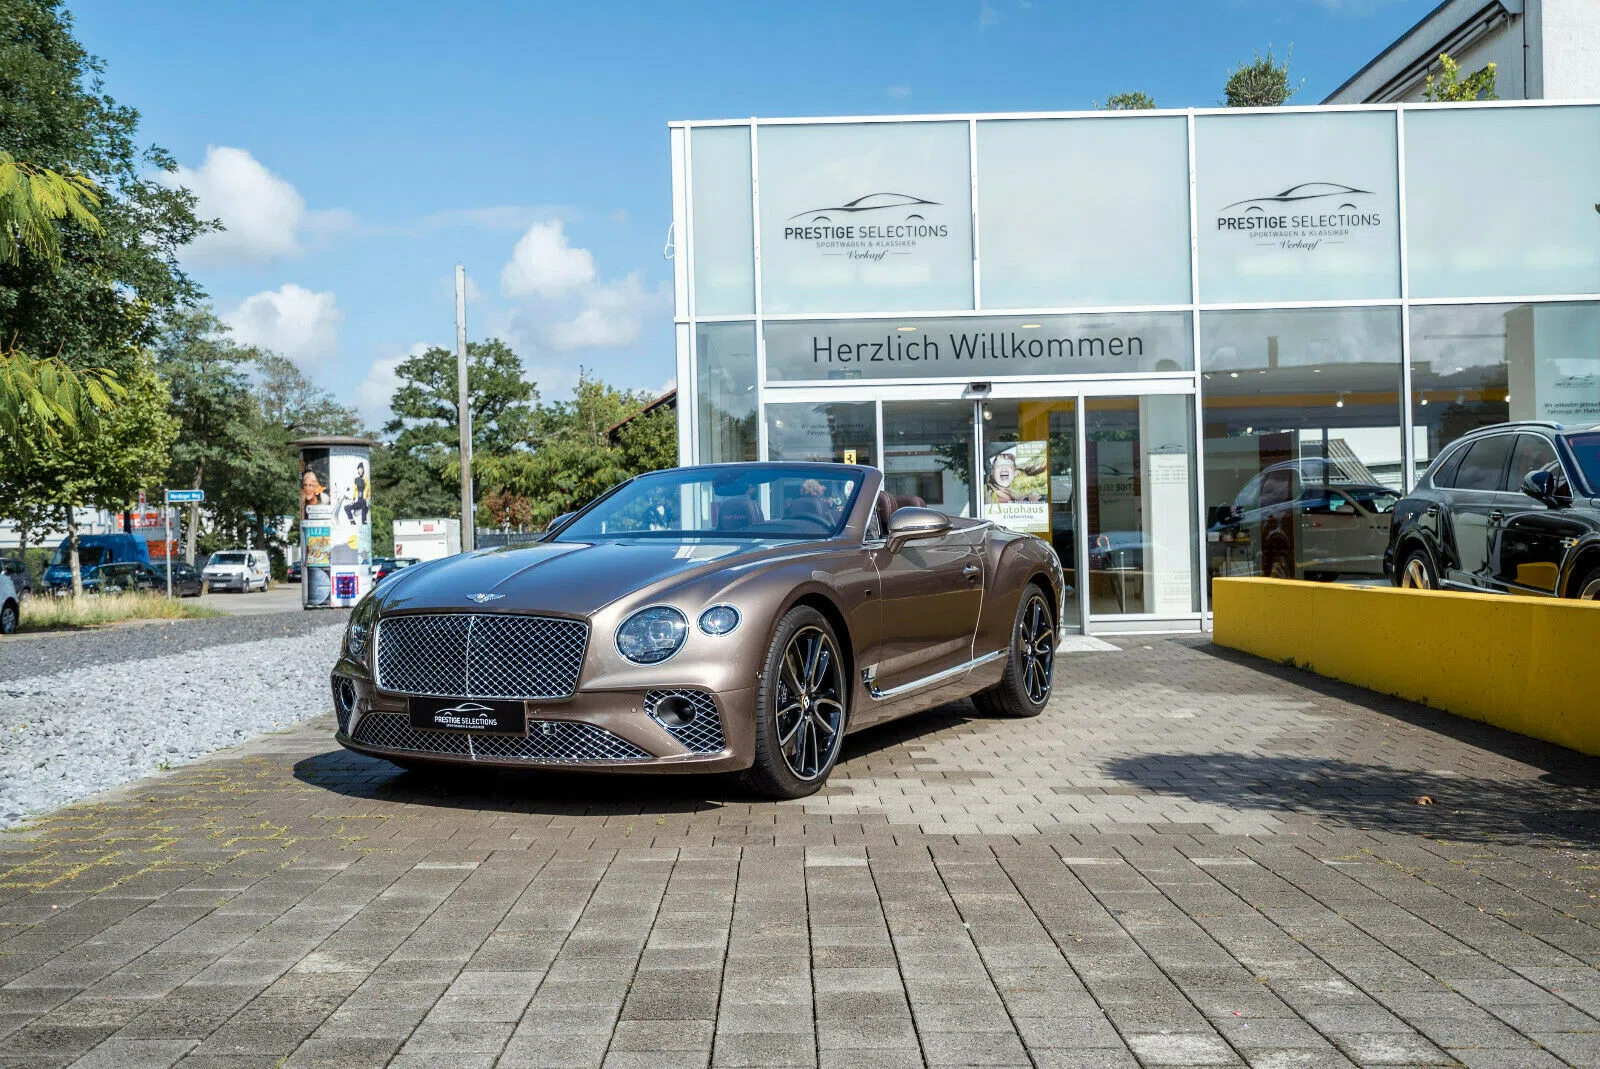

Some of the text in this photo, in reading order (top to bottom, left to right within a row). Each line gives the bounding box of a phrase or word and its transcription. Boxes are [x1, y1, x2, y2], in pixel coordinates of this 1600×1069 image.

[1217, 214, 1381, 230] PRESTIGE SELECTIONS
[784, 225, 948, 240] PRESTIGE SELECTIONS
[1279, 239, 1322, 251] Verkauf
[846, 250, 889, 262] Verkauf
[813, 332, 1144, 363] Herzlich Willkommen
[988, 490, 1044, 514] Autohaus
[434, 715, 498, 726] PRESTIGE SELECTIONS
